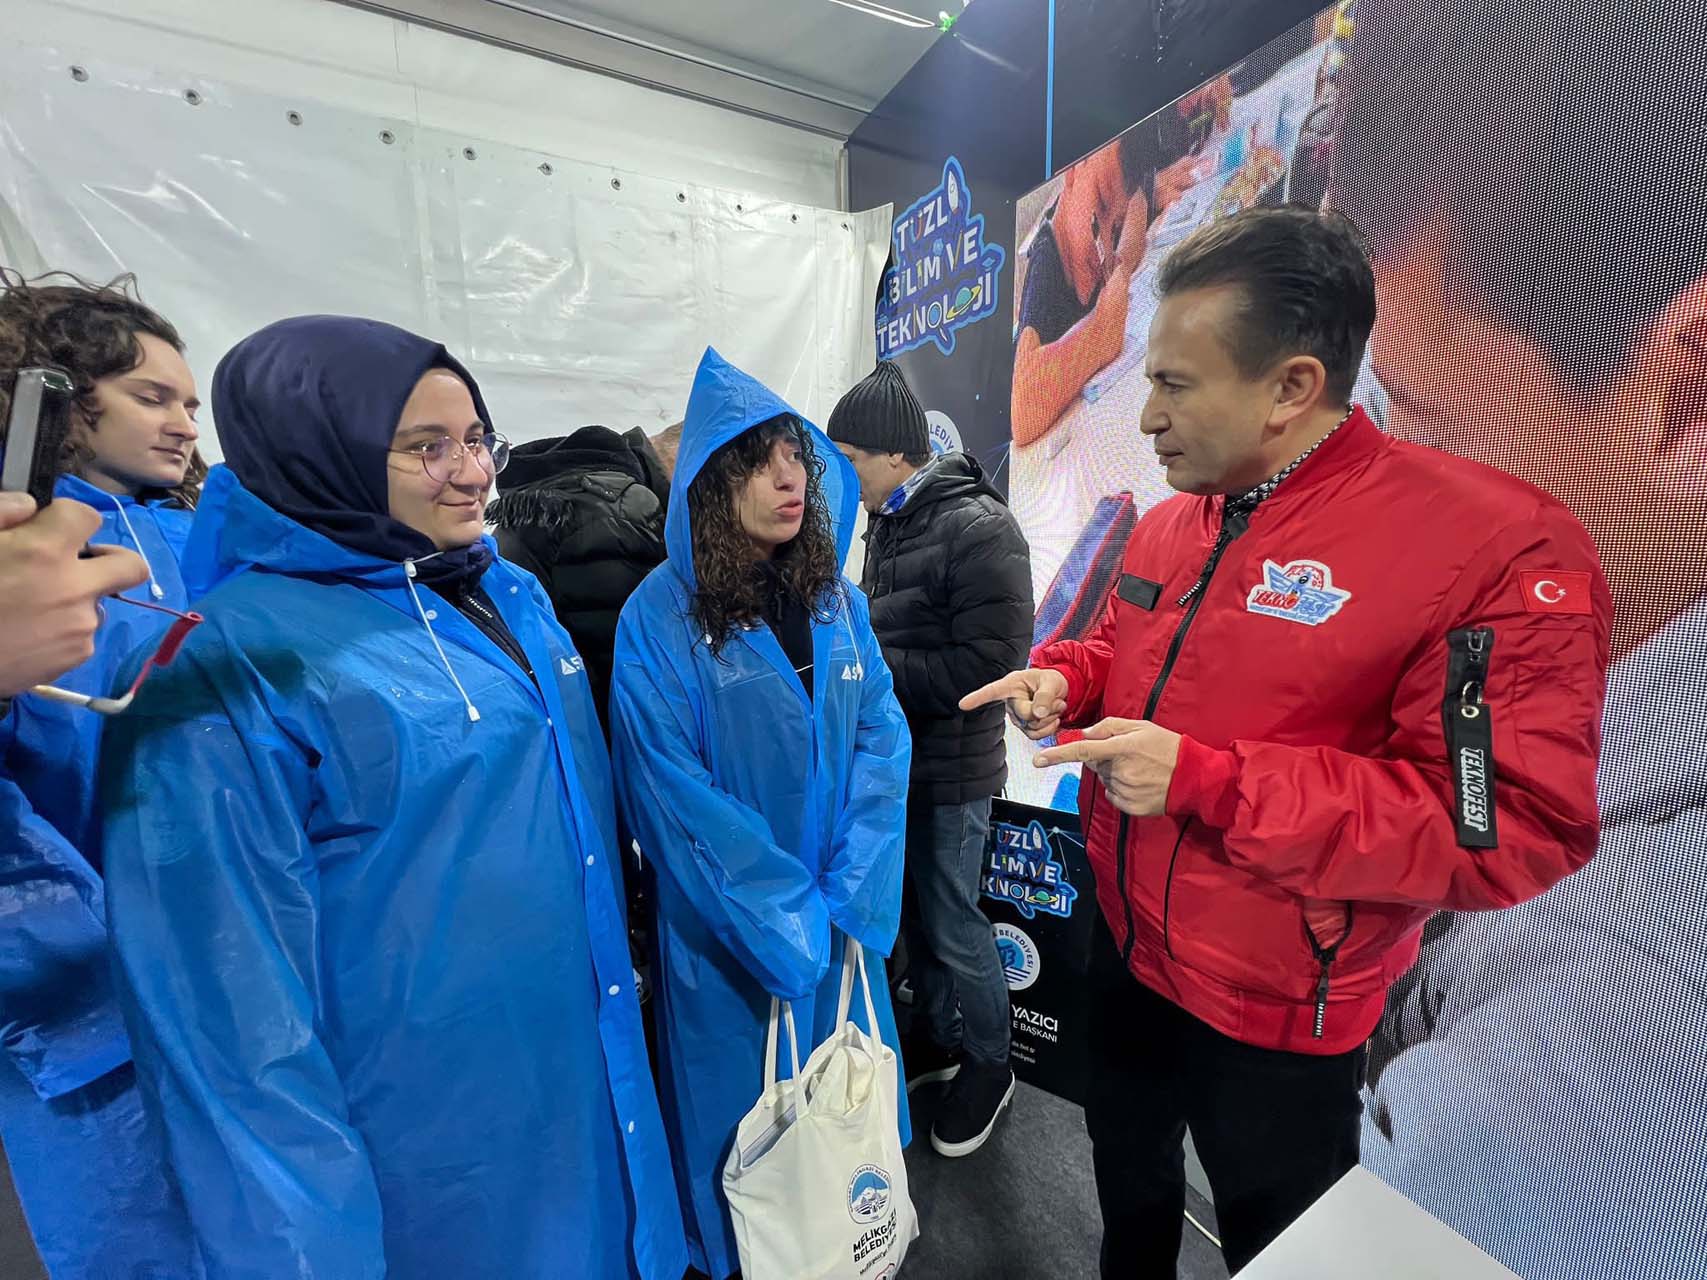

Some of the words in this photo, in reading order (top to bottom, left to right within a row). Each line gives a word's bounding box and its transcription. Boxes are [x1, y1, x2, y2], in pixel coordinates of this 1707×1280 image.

[946, 226, 978, 272] VE
[1460, 746, 1489, 832] TEKNOFEST
[1029, 861, 1057, 884] VE
[1011, 1003, 1058, 1032] YAZICI
